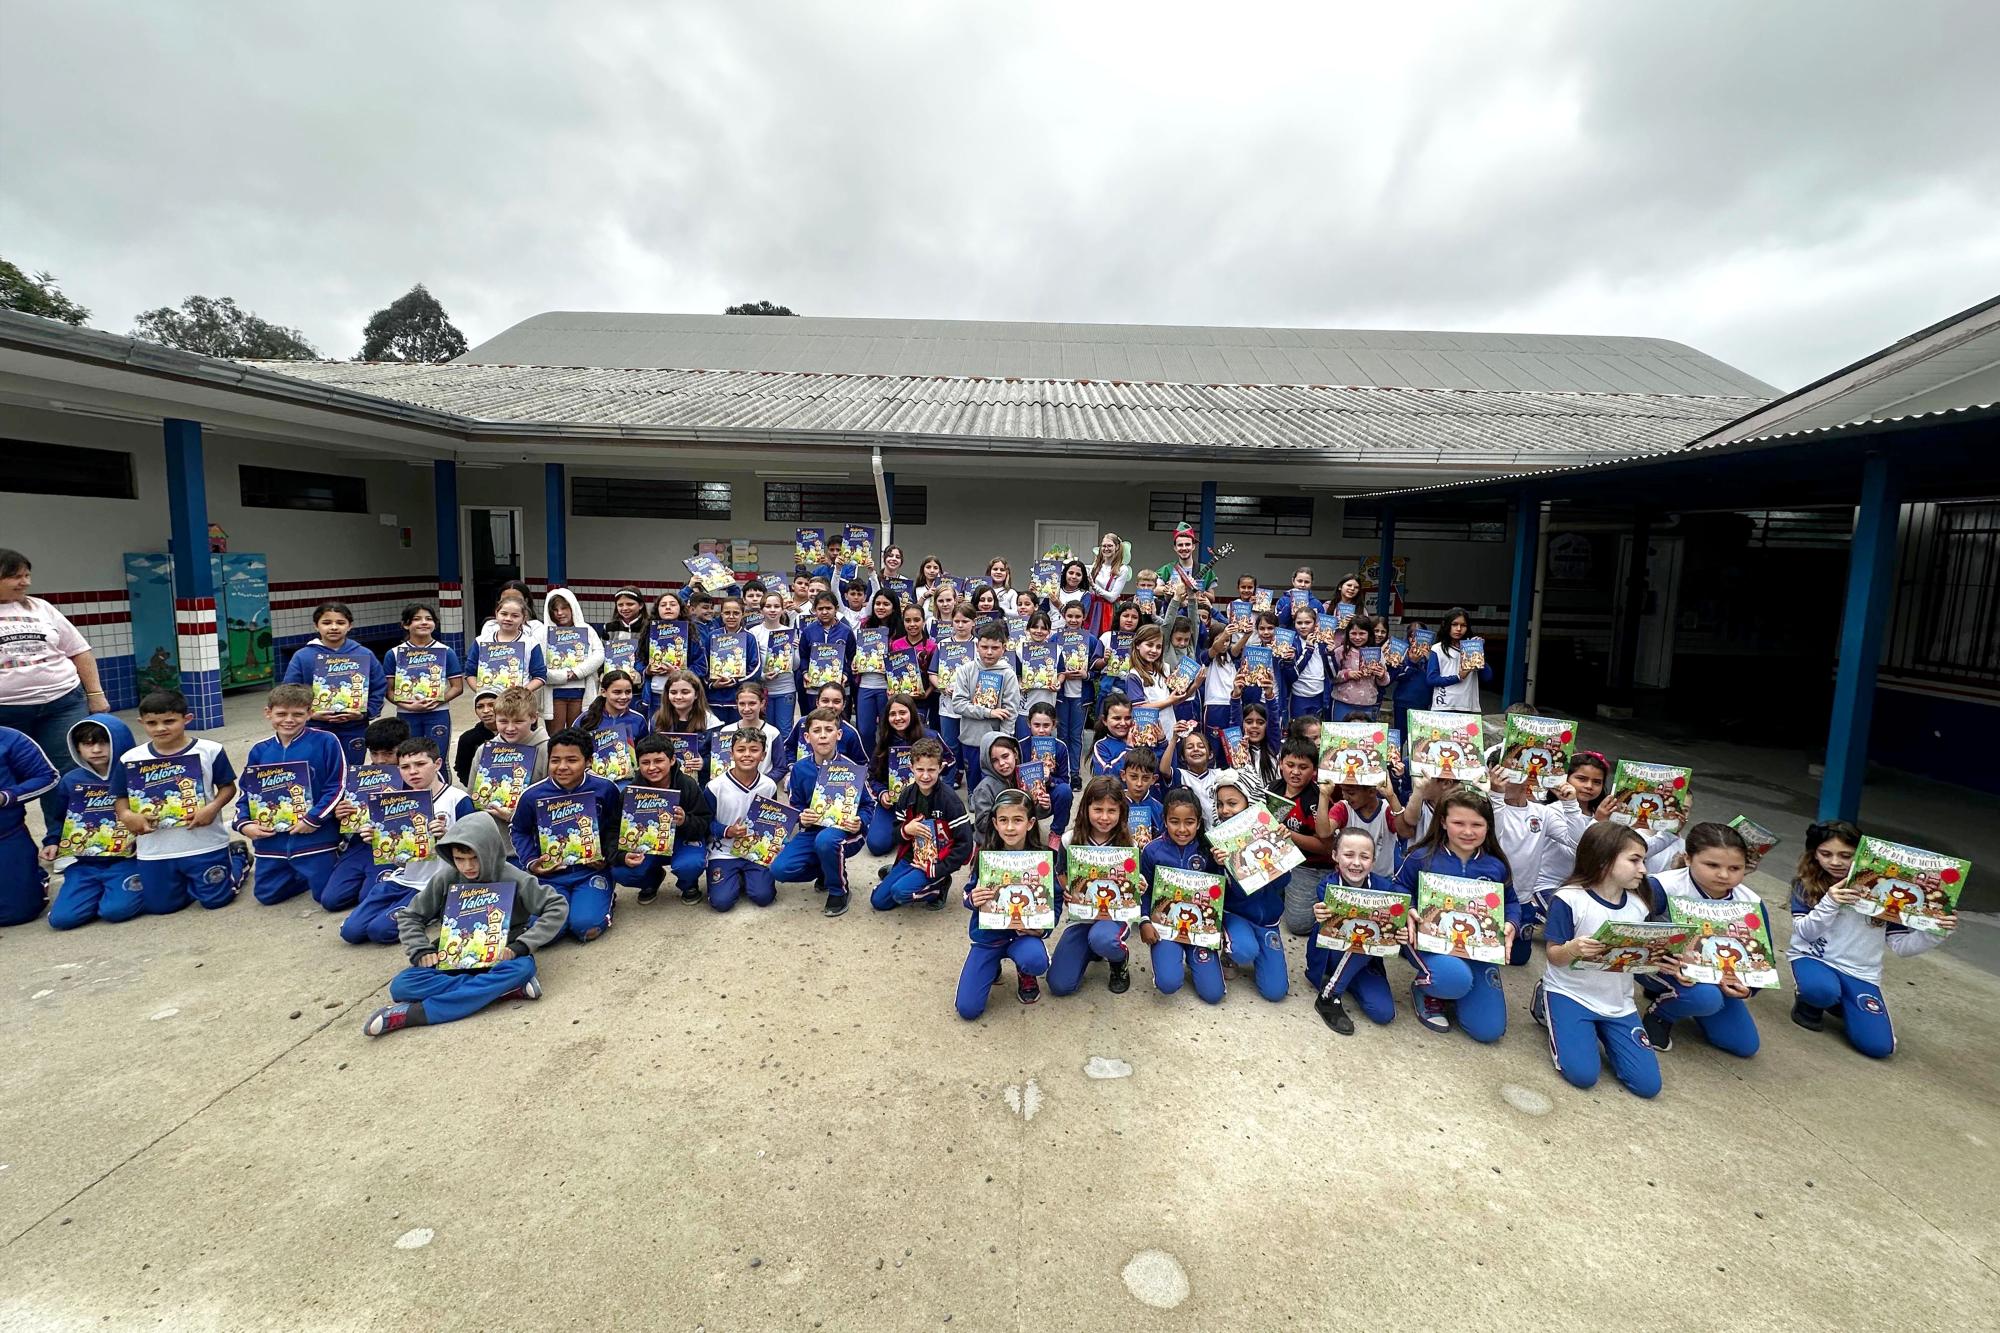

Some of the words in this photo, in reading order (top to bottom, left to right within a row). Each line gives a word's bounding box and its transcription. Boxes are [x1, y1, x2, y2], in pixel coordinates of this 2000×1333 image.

[2, 634, 42, 642] SABEDORIA
[408, 654, 437, 664] Valores
[328, 662, 360, 672] Valores
[598, 732, 619, 746] Valores
[492, 754, 524, 763] Valores
[139, 761, 171, 773] Histórias
[144, 765, 186, 783] Valores
[256, 768, 284, 779] Histórias
[828, 771, 856, 781] Valores
[261, 773, 297, 788] Valores
[358, 775, 392, 787] Valores
[380, 796, 407, 806] Histórias
[634, 792, 659, 801] Histórias
[86, 797, 115, 808] Valor
[547, 800, 572, 811] Histórias
[636, 800, 668, 809] Valores
[384, 802, 420, 816] Valores
[551, 804, 584, 820] Valores
[759, 810, 788, 822] Valores
[1891, 851, 1903, 861] DIA
[1907, 856, 1916, 864] NO
[1919, 858, 1940, 868] HOTEL
[459, 888, 489, 898] Histórias
[460, 892, 500, 910] Valores
[1698, 907, 1710, 916] DIA
[1712, 909, 1721, 917] NO
[1722, 907, 1739, 916] HOTEL
